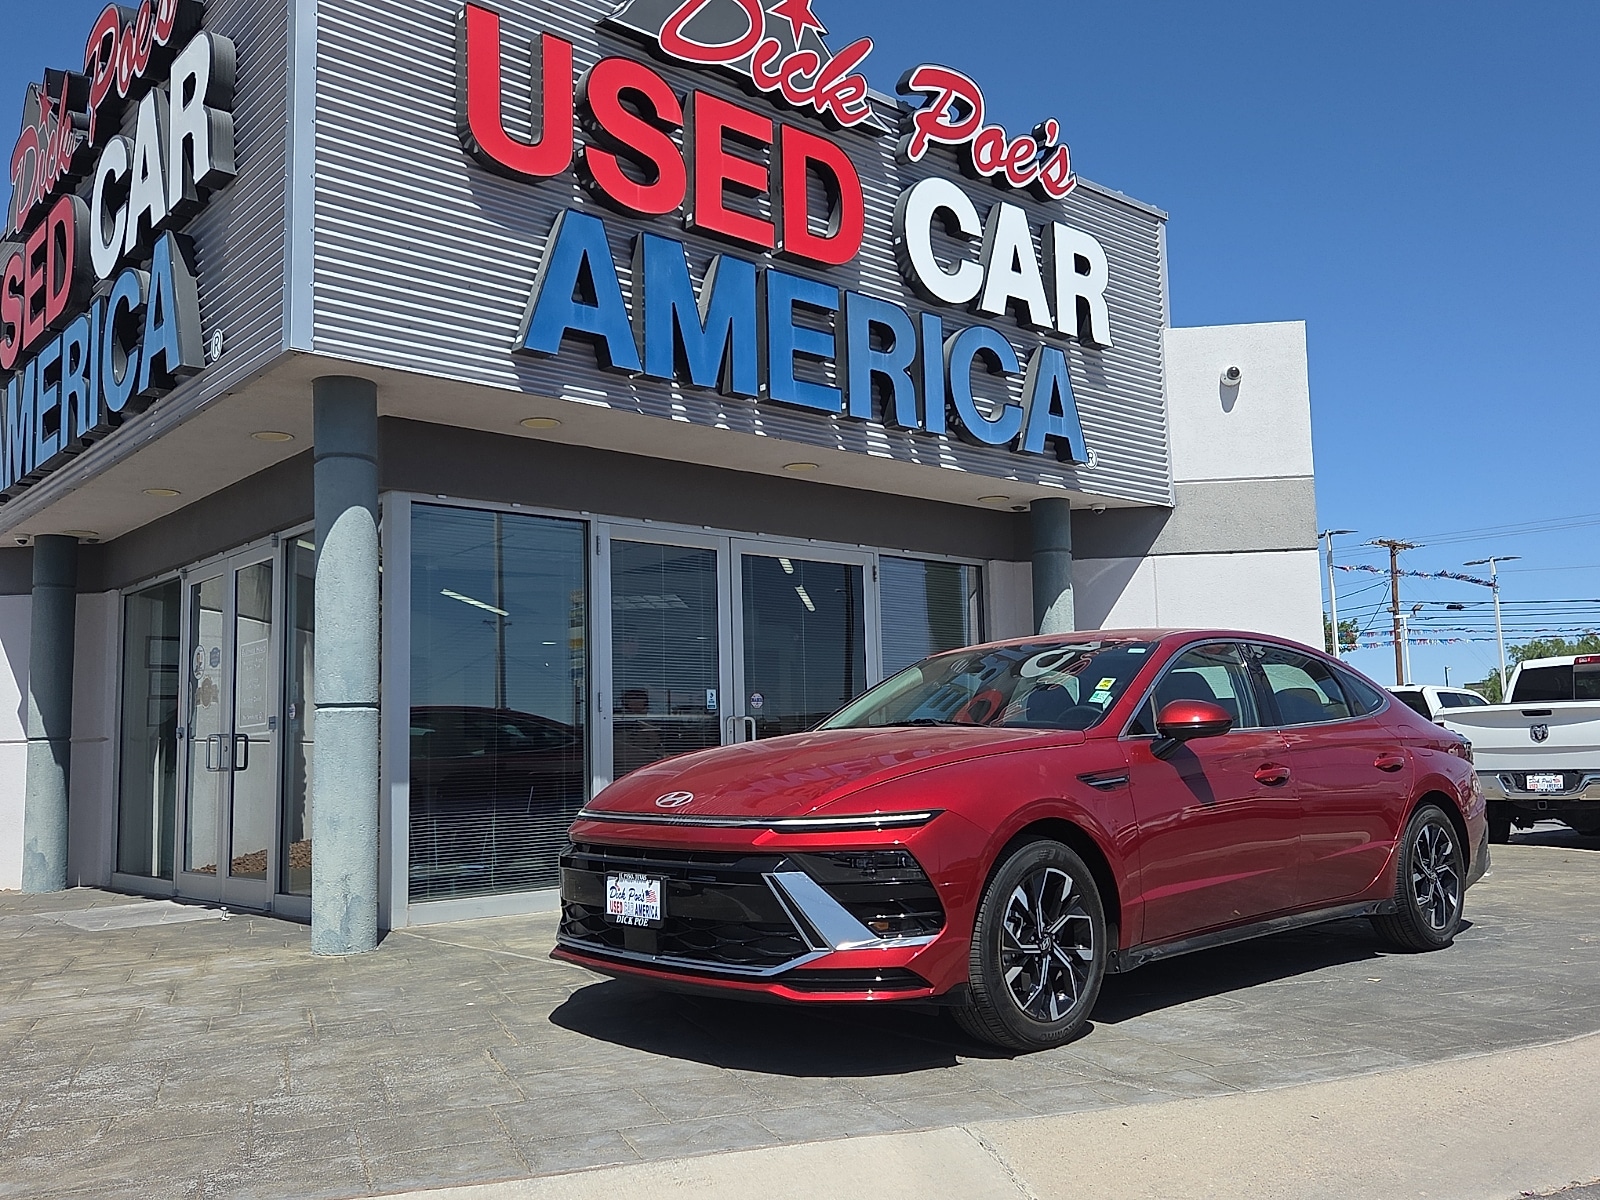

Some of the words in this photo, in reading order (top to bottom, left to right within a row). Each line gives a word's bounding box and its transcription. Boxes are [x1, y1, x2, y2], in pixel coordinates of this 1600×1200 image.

[90, 31, 211, 279] CAR
[463, 3, 865, 267] USED
[902, 177, 1113, 347] CAR
[658, 0, 877, 128] Dick
[905, 63, 1076, 200] Poe's
[0, 230, 182, 492] MERICA
[515, 208, 1090, 465] AMERICA
[610, 886, 626, 899] Dick
[610, 900, 623, 914] USED
[635, 903, 658, 918] AMERICA
[616, 915, 632, 925] DICK
[634, 917, 648, 927] POE
